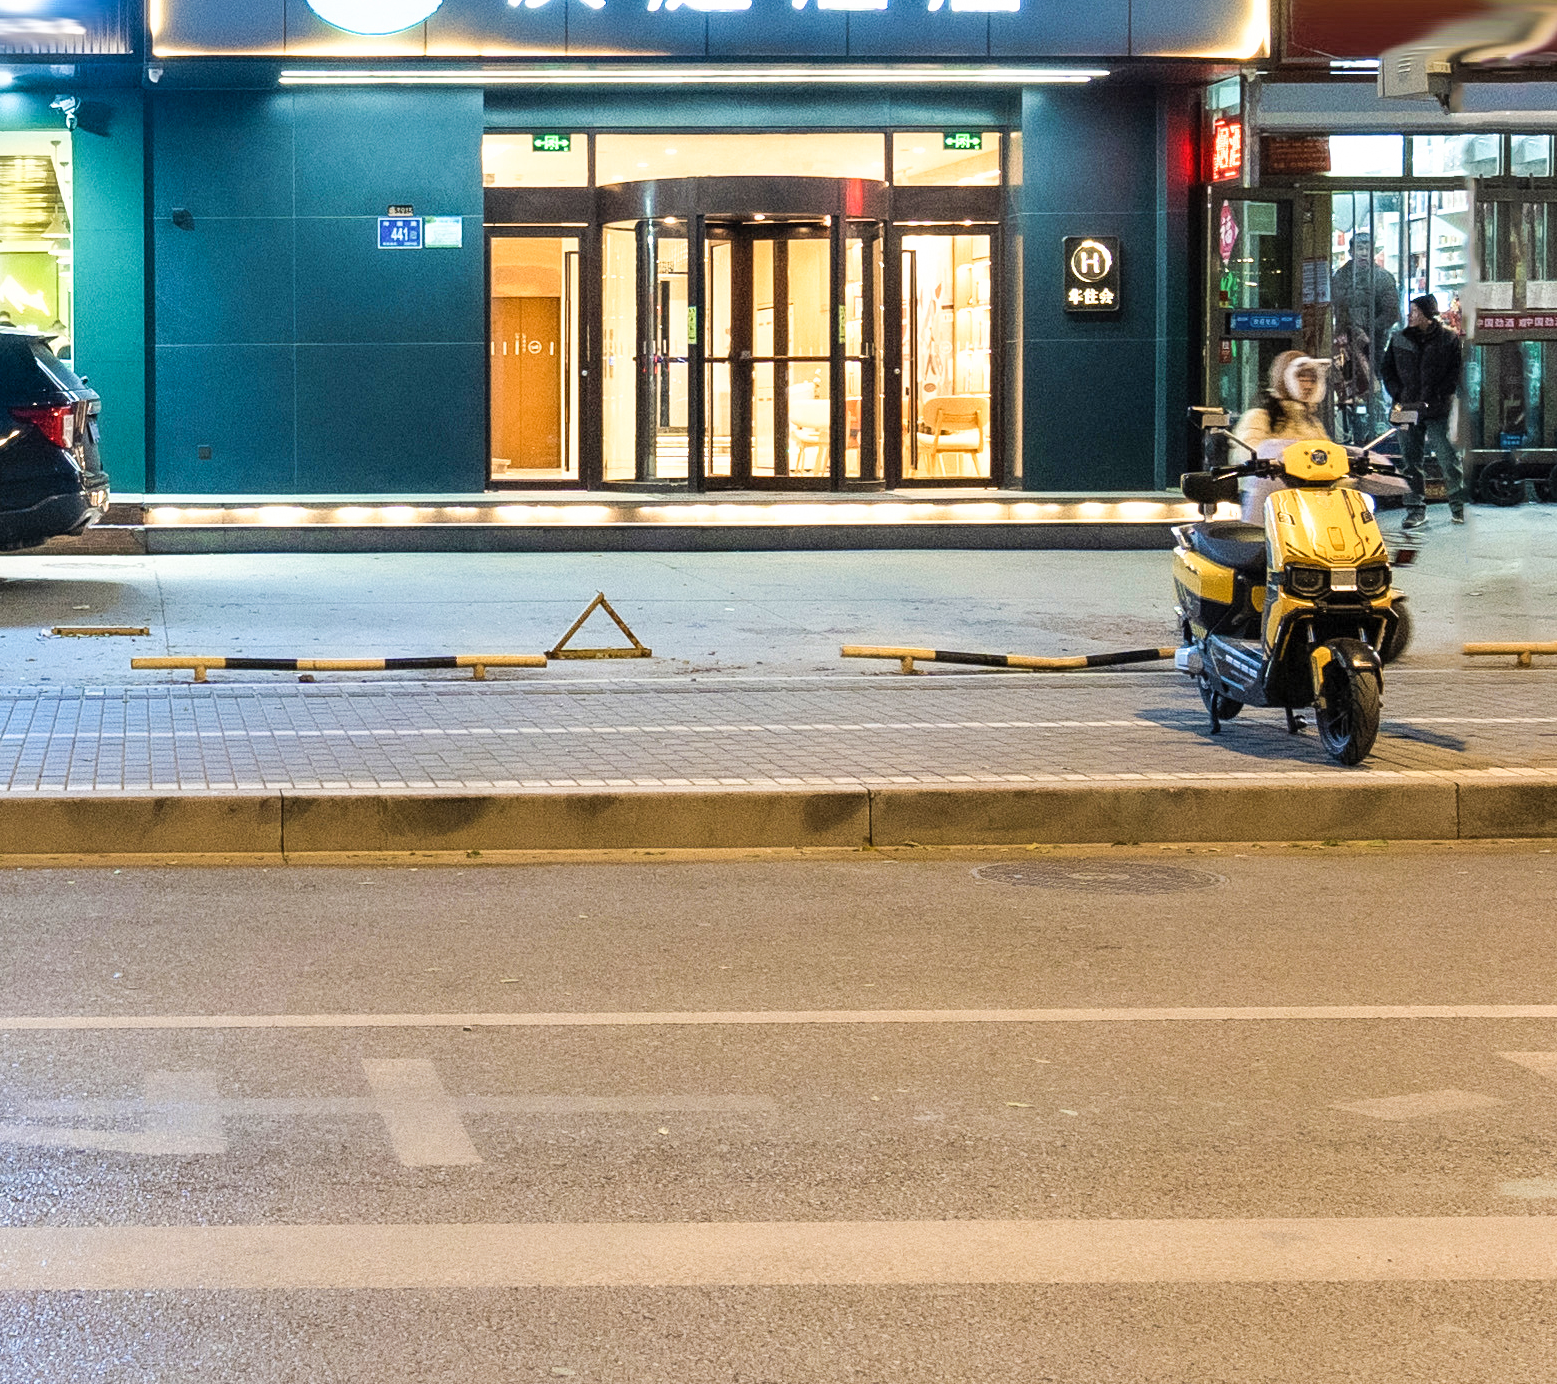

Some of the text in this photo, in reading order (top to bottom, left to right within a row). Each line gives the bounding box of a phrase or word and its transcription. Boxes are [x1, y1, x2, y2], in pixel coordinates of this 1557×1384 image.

[390, 227, 409, 241] 441
[1080, 251, 1101, 274] H
[1068, 288, 1115, 305] 华住会
